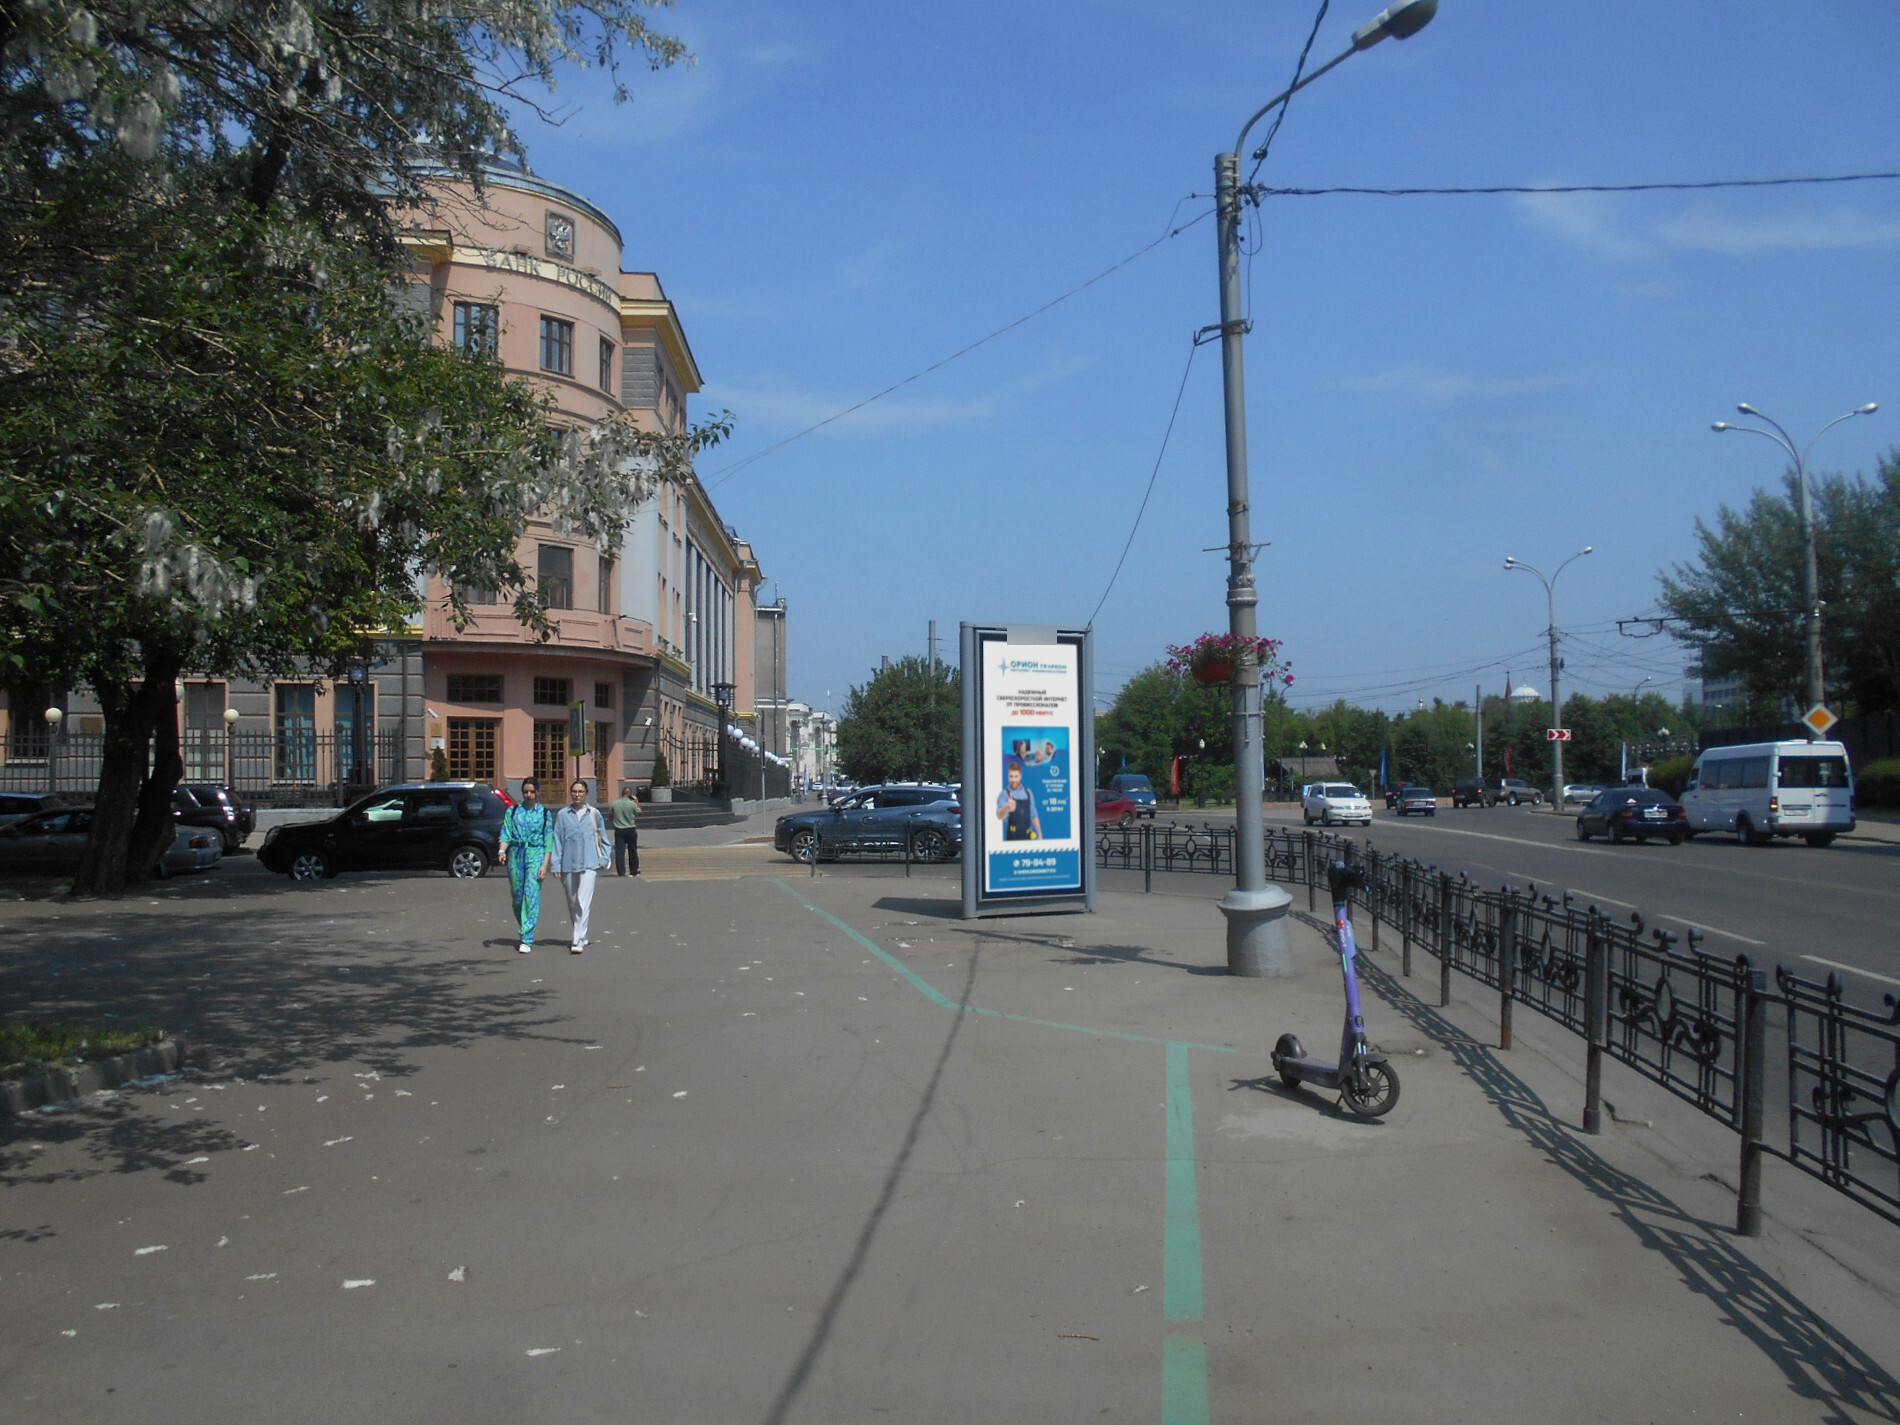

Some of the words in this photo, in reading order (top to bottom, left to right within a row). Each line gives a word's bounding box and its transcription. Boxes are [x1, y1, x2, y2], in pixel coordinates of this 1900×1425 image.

[487, 249, 541, 276] БАНК
[557, 264, 612, 304] РОССИИ
[1010, 660, 1039, 669] ОРИОН
